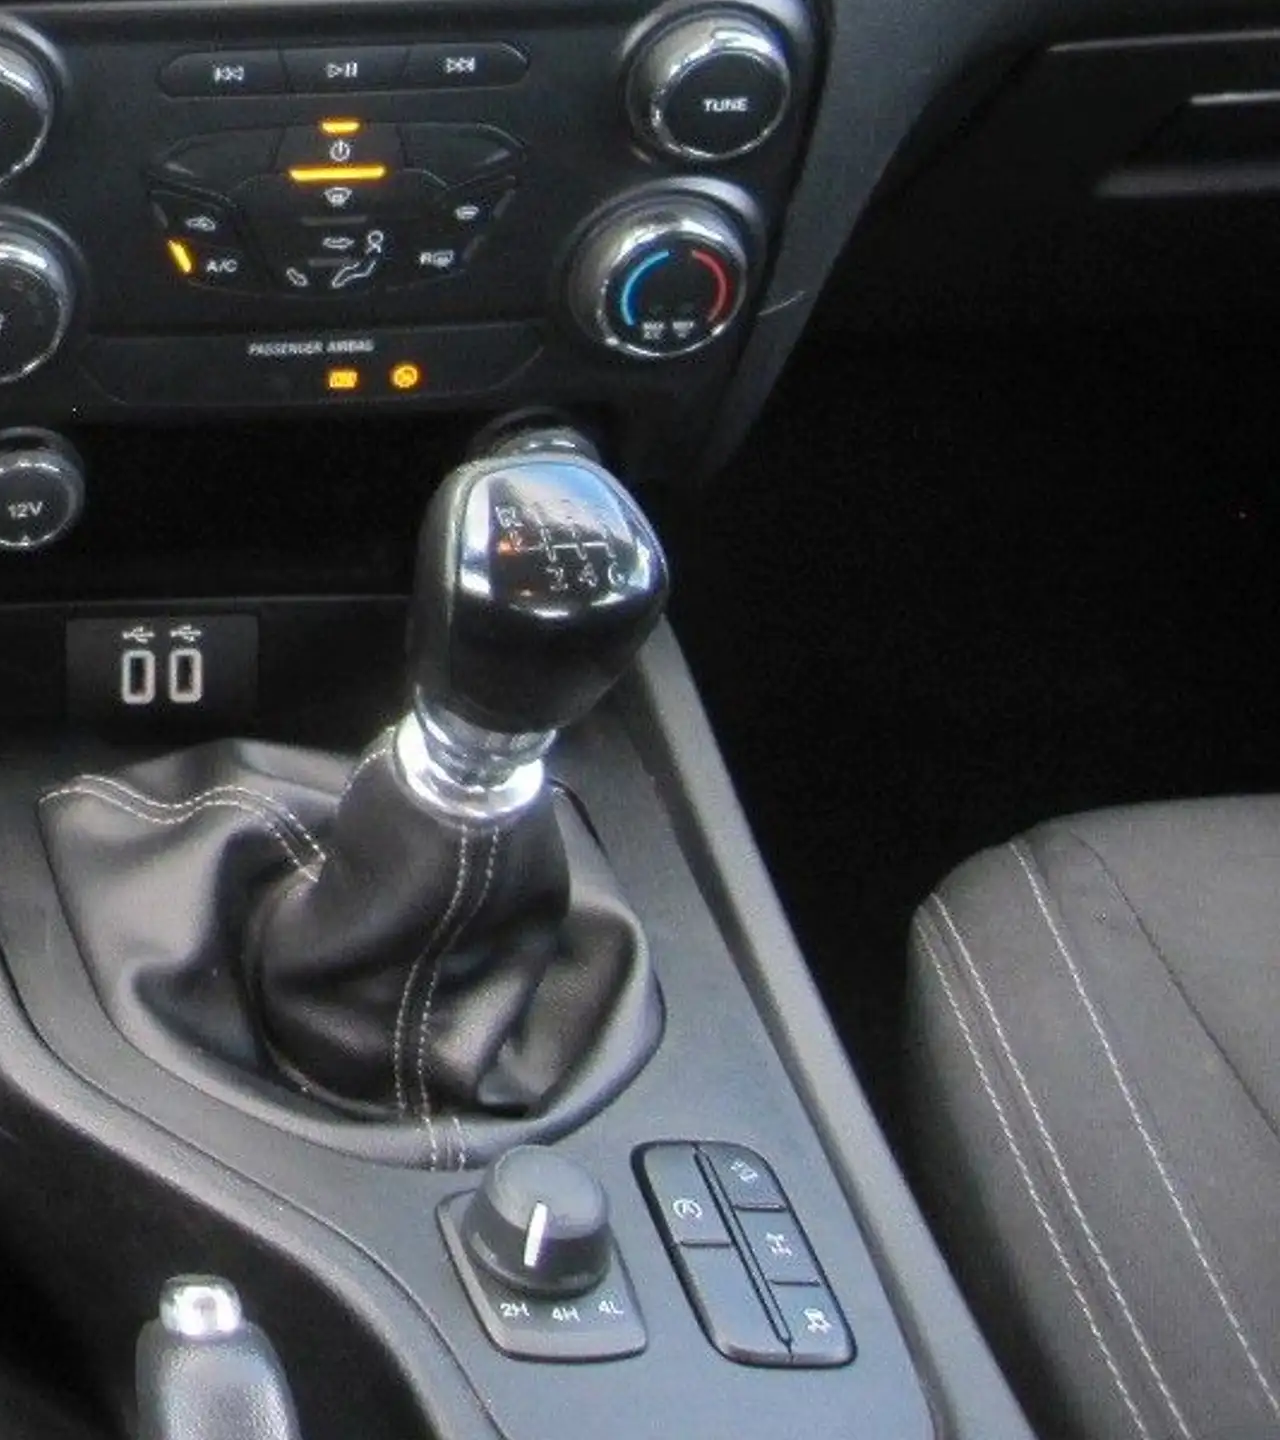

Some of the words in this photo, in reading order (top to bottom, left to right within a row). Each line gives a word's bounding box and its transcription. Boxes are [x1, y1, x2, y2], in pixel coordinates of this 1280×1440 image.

[703, 97, 749, 112] TUNE
[206, 259, 238, 273] A/C
[247, 342, 323, 356] PASSENGER
[326, 339, 375, 353] AIRBAG
[7, 501, 43, 519] 12V
[500, 1302, 530, 1317] 2H
[552, 1307, 581, 1322] 4H
[598, 1300, 624, 1315] 4L
